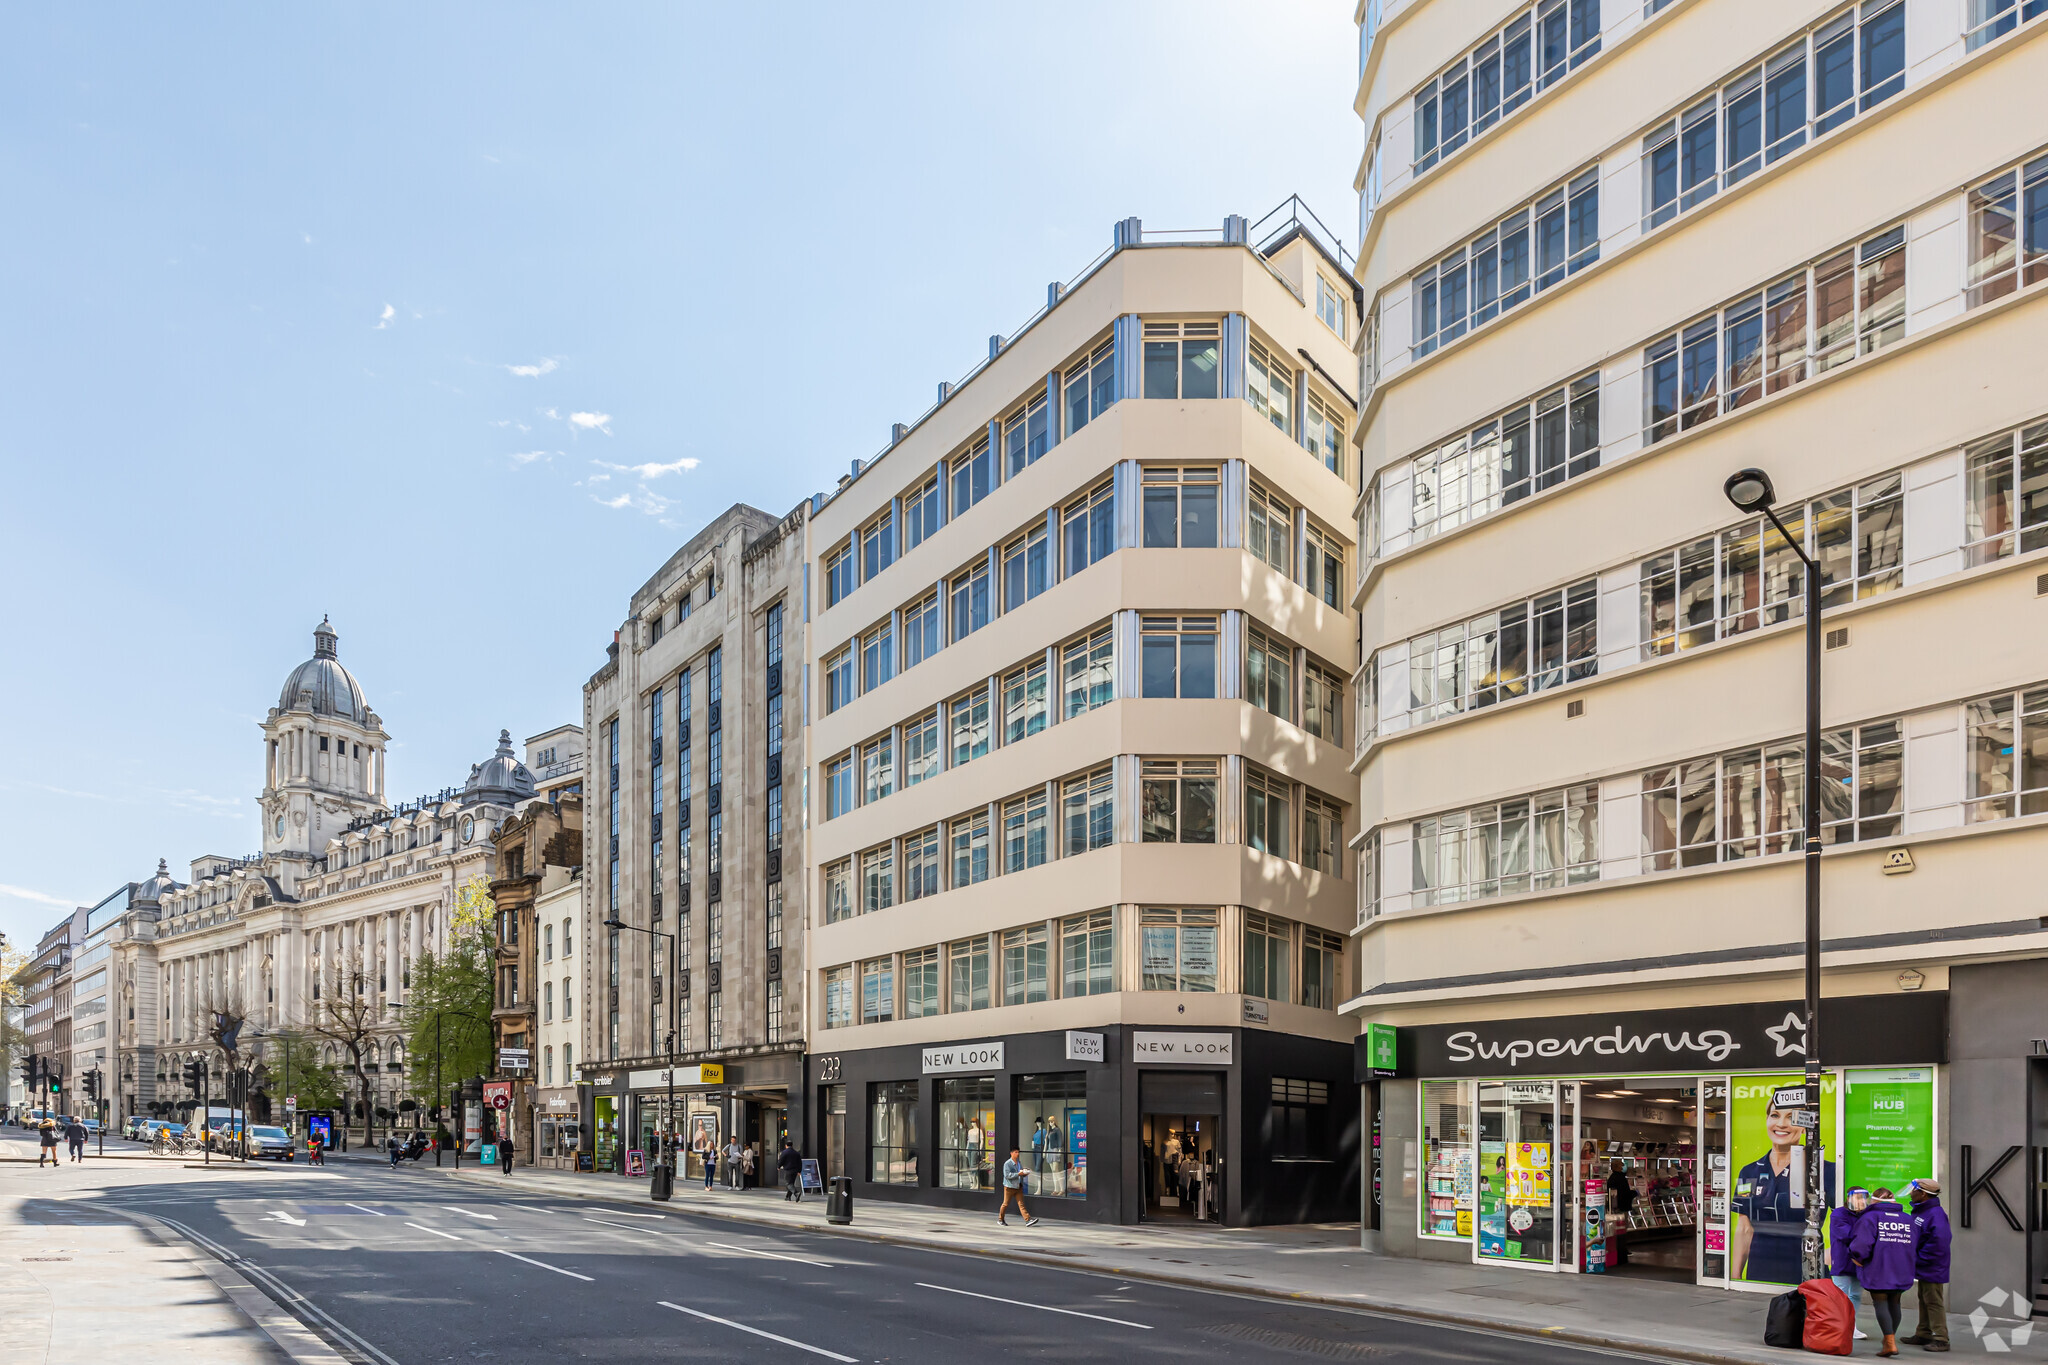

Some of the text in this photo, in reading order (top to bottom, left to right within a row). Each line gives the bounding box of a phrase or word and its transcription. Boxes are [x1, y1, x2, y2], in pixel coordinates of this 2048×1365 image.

[1373, 1026, 1395, 1036] Pharmacy
[1076, 1038, 1098, 1046] NEW
[1446, 1025, 1741, 1067] Superdrug
[1074, 1046, 1100, 1055] LOOK
[1136, 1042, 1229, 1053] NEW LOOK
[924, 1049, 1000, 1067] NEW LOOK
[703, 1068, 719, 1077] itsu
[820, 1056, 842, 1081] 233
[550, 1094, 567, 1108] Fabrique
[1780, 1092, 1804, 1102] TOILET
[1873, 1100, 1905, 1110] HUB
[1866, 1124, 1904, 1132] Pharmacy
[1878, 1221, 1911, 1233] SCOPE
